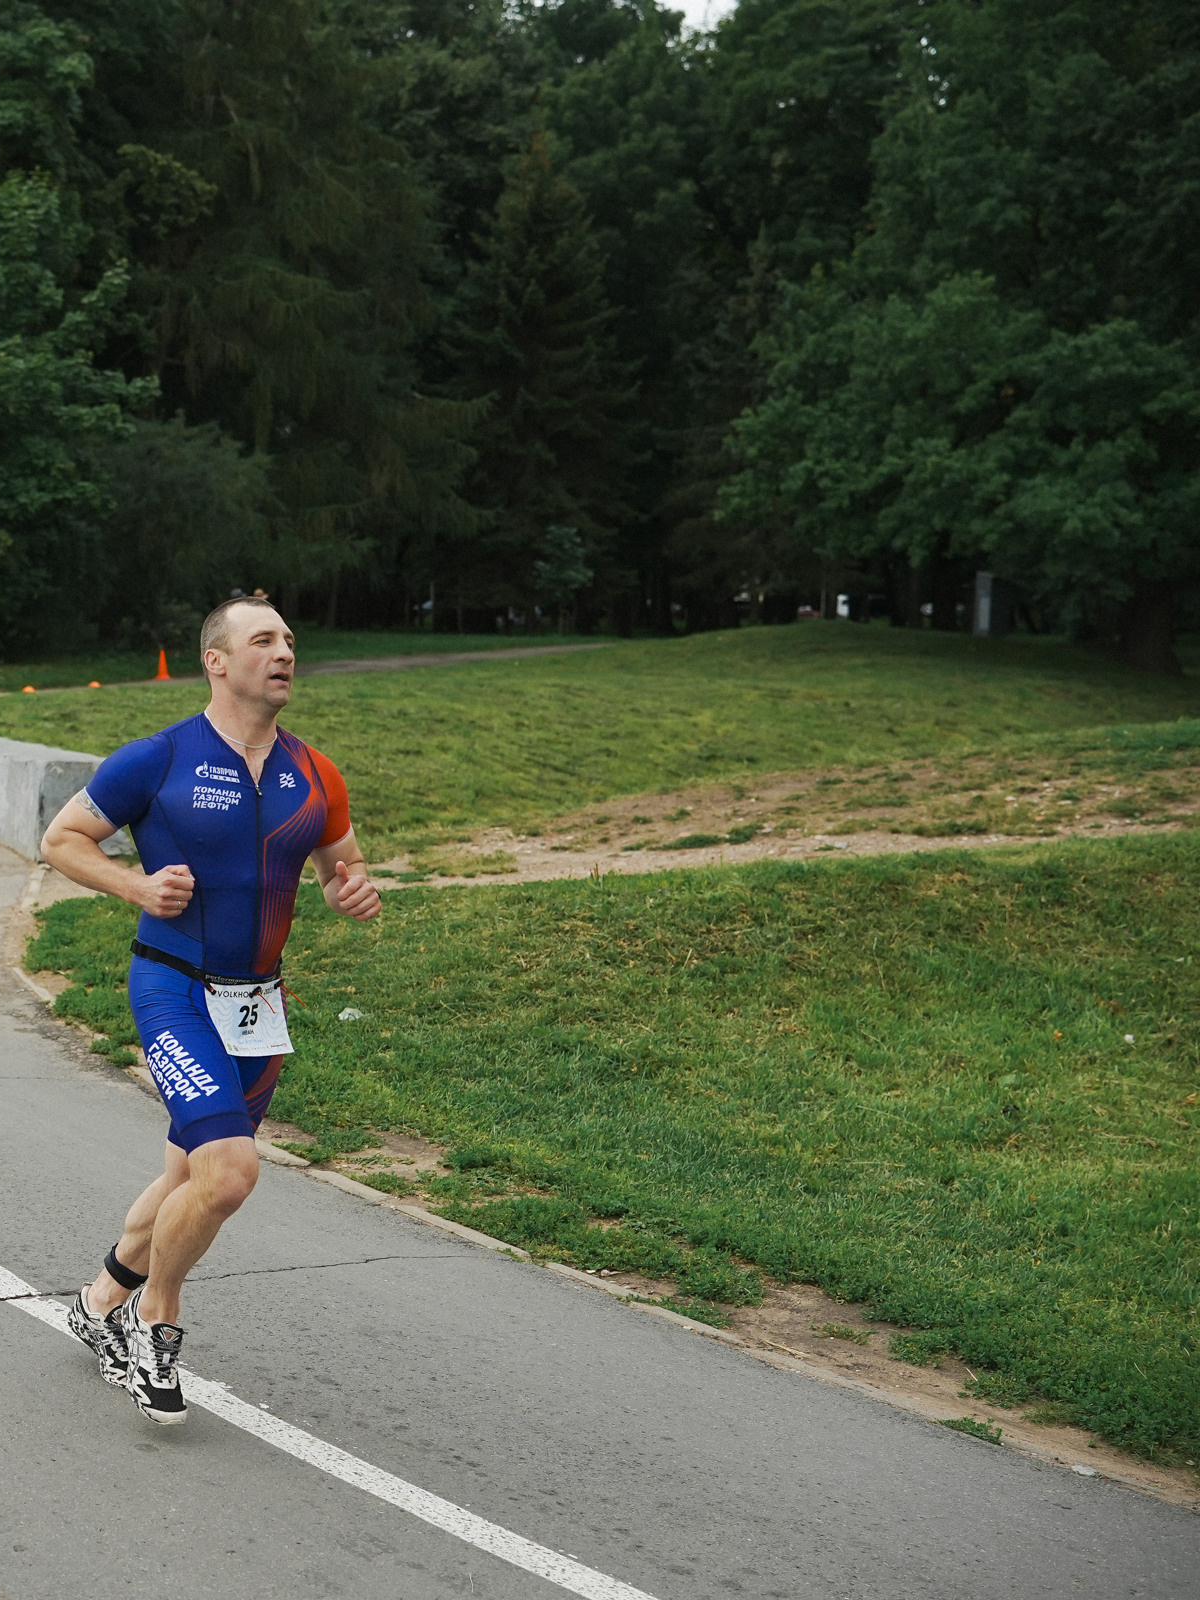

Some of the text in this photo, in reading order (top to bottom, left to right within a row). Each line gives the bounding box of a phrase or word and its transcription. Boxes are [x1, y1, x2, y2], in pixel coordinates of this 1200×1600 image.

[209, 766, 239, 777] ГАЗПРОМ
[193, 785, 242, 799] КОМАНДА
[193, 793, 239, 805] ГАЗПРОМ
[193, 801, 229, 811] НЕФТИ
[238, 1004, 259, 1027] 25
[148, 1042, 202, 1102] ГАЗПРОМ
[155, 1030, 220, 1097] КОМАНДА
[146, 1054, 176, 1100] НЕФТИ
